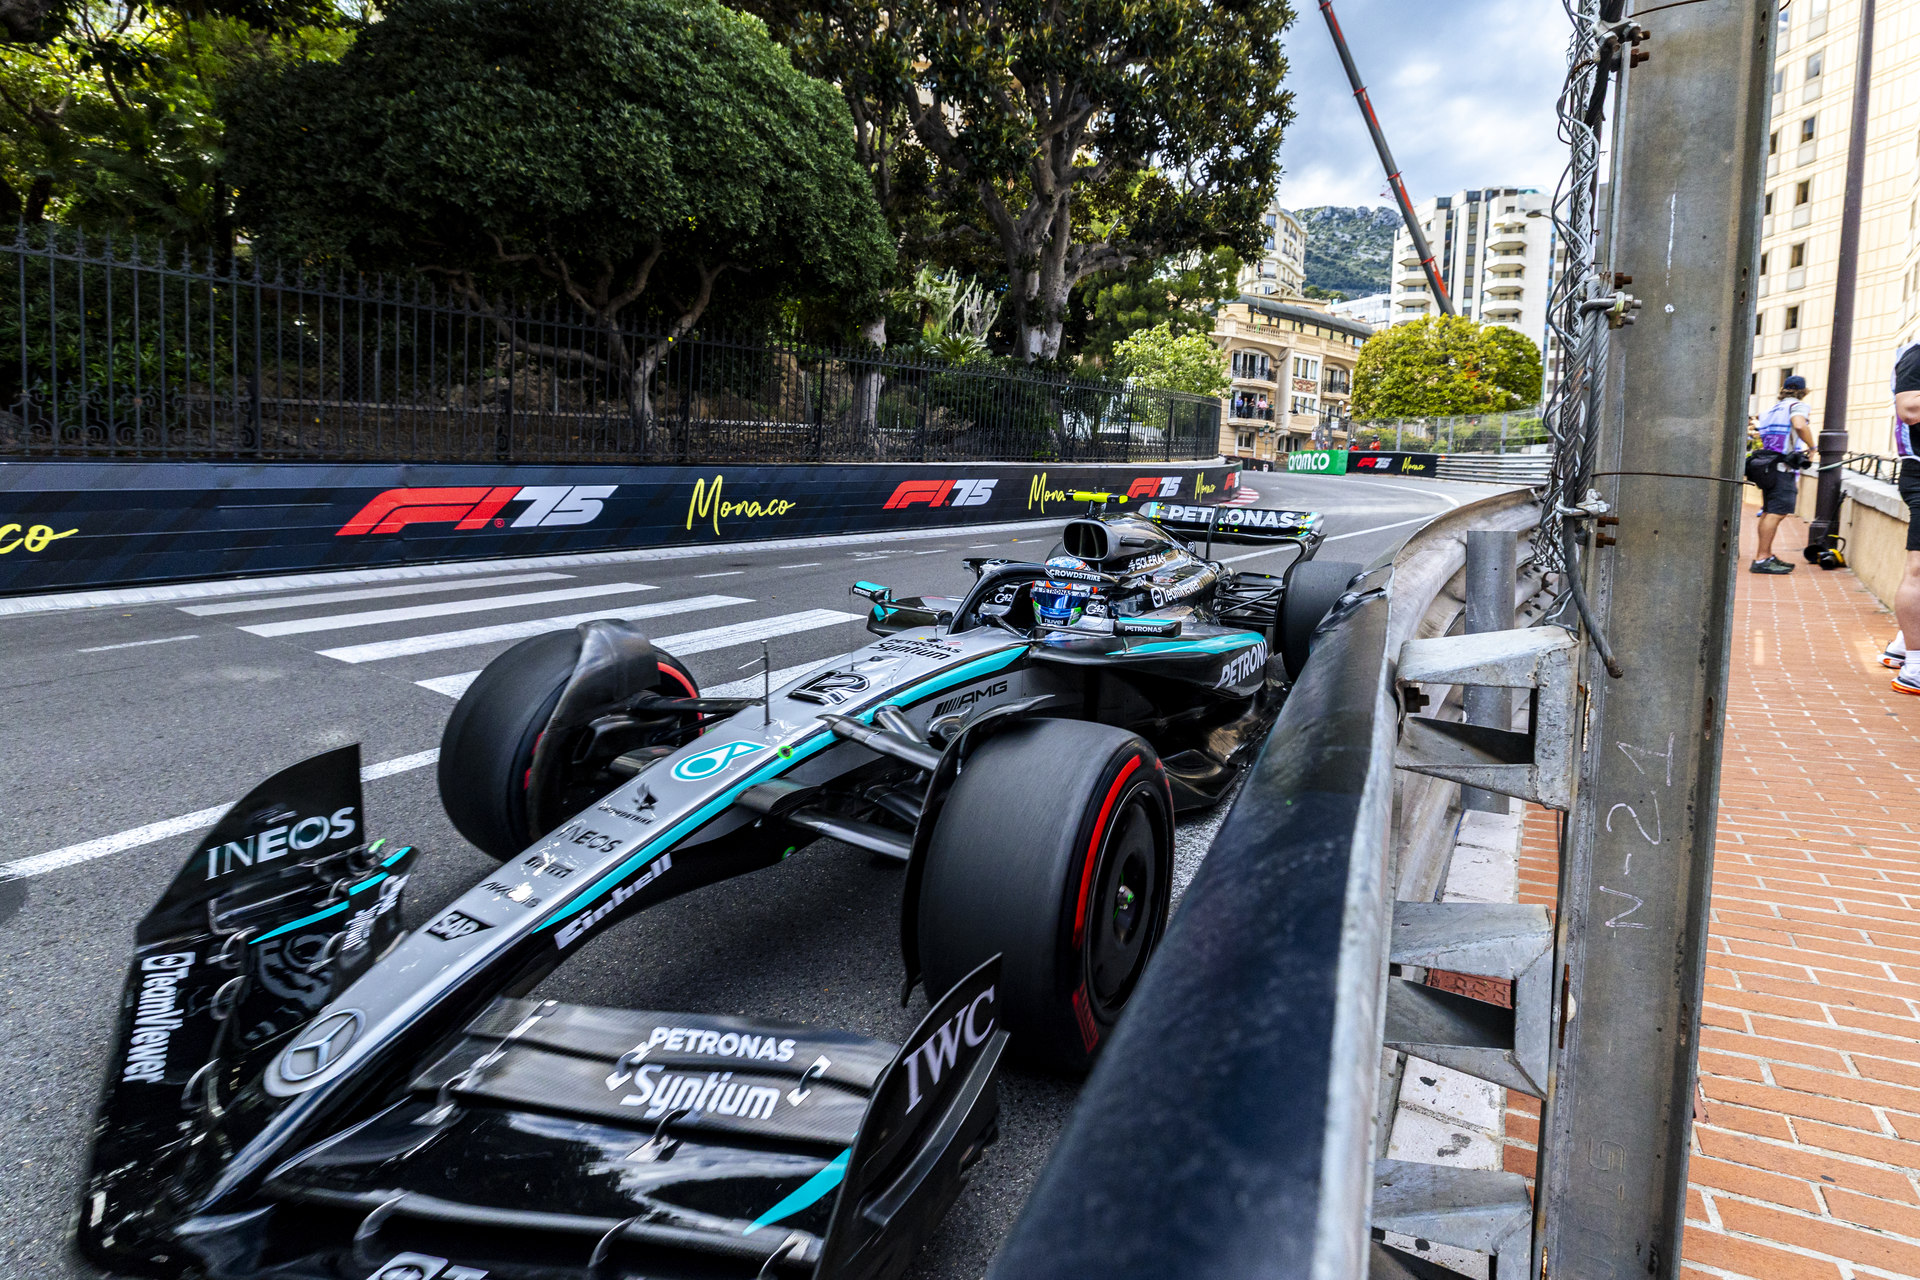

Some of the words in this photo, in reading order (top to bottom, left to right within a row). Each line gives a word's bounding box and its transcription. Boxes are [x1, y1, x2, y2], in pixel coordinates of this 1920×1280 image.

[1288, 453, 1330, 471] aramco
[510, 485, 618, 527] 75
[687, 475, 796, 535] Monaco
[950, 479, 999, 506] 75
[1028, 472, 1077, 514] Mona
[1167, 504, 1295, 528] PETONAS
[1049, 569, 1101, 582] CROWDSTRIKE
[884, 638, 963, 654] PETRONAS
[1124, 625, 1163, 633] PETRONAS
[957, 680, 1008, 710] AMG
[204, 806, 356, 882] INEOS
[554, 852, 673, 950] Einhell
[431, 912, 480, 940] SAP
[121, 966, 190, 1083] TeamViewer
[647, 1026, 797, 1063] PETRONAS
[902, 985, 996, 1115] IWC
[619, 1064, 781, 1120] Syntium
